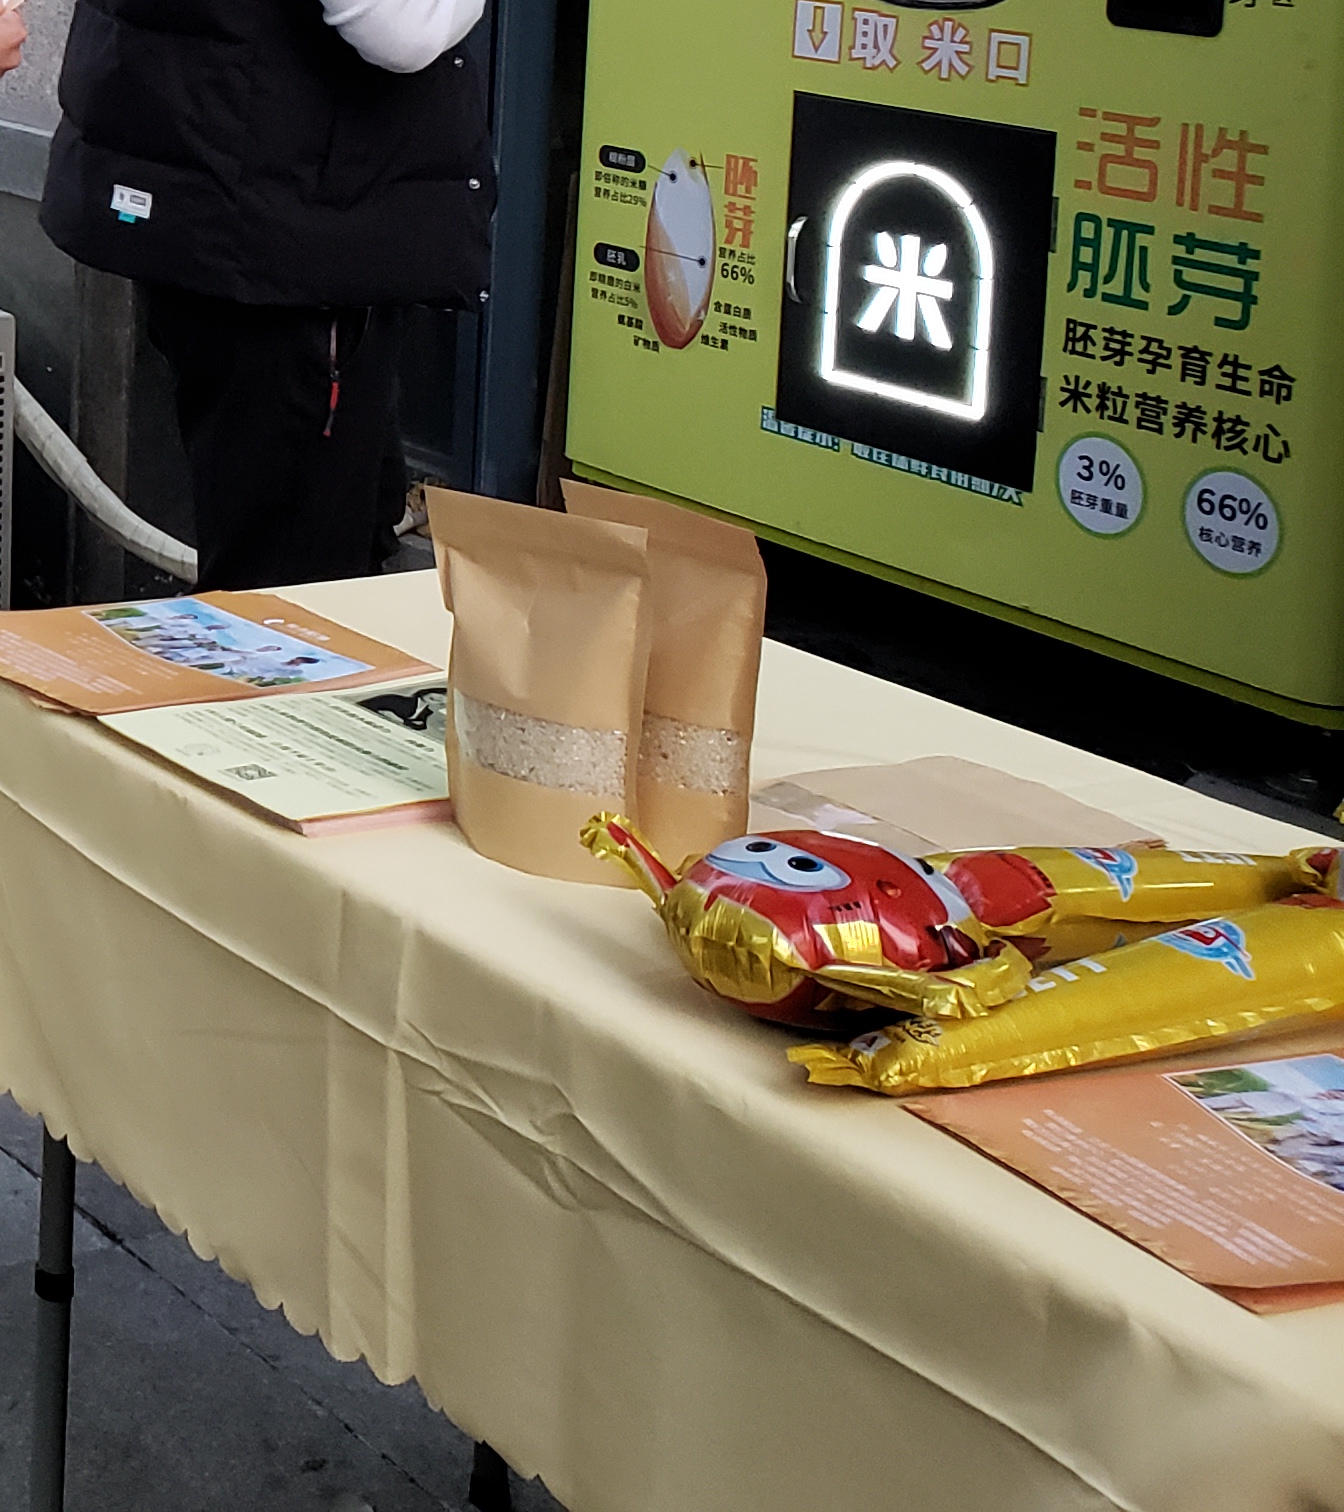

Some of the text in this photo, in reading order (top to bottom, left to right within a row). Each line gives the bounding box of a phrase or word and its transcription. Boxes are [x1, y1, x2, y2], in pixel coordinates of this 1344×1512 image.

[1073, 106, 1270, 224] 活性
[720, 262, 756, 285] 66%
[855, 230, 955, 353] 米
[1066, 211, 1262, 331] 胚芽
[1062, 317, 1298, 406] 胚芽孕育生命
[1058, 373, 1292, 466] 米粒营养核心
[1076, 454, 1127, 492] 3%
[1196, 487, 1269, 531] 66%
[1198, 524, 1263, 559] 核心营养
